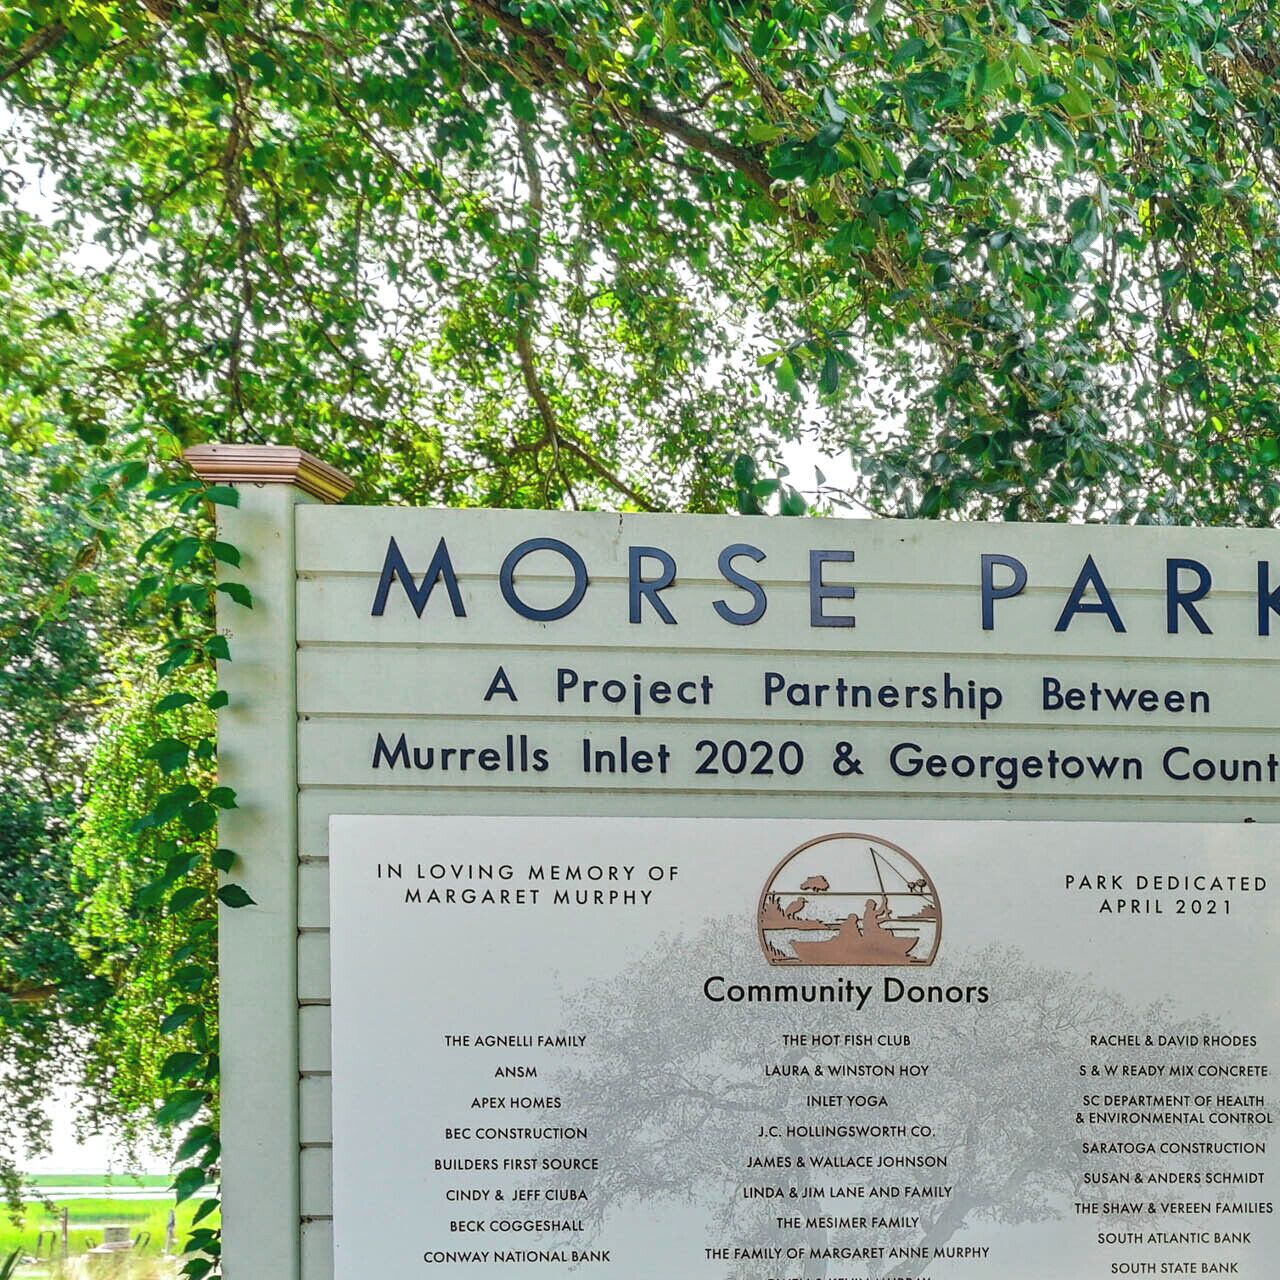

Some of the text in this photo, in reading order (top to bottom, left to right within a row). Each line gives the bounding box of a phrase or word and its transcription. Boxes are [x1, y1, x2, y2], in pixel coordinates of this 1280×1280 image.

[371, 537, 856, 627] MORSE
[485, 668, 1210, 714] A Project Partnership Between
[372, 733, 550, 774] Murrells
[581, 736, 671, 775] Inlet
[695, 739, 805, 775] 2020
[833, 742, 865, 776] &
[889, 743, 1144, 790] Georgetown
[377, 863, 678, 881] IN LOVING MEMORY OF
[1065, 874, 1266, 892] PARK DEDICATED
[405, 888, 652, 905] MARGARET MURPHY
[1099, 898, 1230, 915] APRIL 2021
[703, 975, 989, 1011] Community Donors
[444, 1035, 587, 1047] THE AGNELLI FAMILY
[782, 1034, 911, 1047] THE HOT FISH CLUB
[1090, 1034, 1257, 1047] RACHEL & DAVID RHODES
[494, 1066, 538, 1078] ANSM
[765, 1064, 929, 1077] LAURA & WINSTON HOY
[470, 1096, 562, 1109] APEX HOMES
[806, 1095, 889, 1107] INLET YOGA
[1082, 1094, 1265, 1107] SC DEPARTMENT OF HEALTH
[1075, 1112, 1273, 1124] & ENVIRONMENTAL CONTROL
[445, 1127, 588, 1140] BEC CONSTRUCTION
[757, 1125, 936, 1138] J.C. HOLLINGSWORTH CO.
[1082, 1142, 1266, 1154] SARATOGA CONSTRUCTION
[434, 1158, 599, 1171] BUILDERS FIRST SOURCE
[746, 1155, 947, 1168] JAMES & WALLACE JOHNSON
[1074, 1202, 1273, 1215] THE SHAW & VEREEN FAMILIES
[450, 1219, 585, 1232] BECK COGGESHALL
[776, 1216, 919, 1229] THE MESIMER FAMILY
[1097, 1232, 1251, 1244] SOUTH ATLANTIC BANK
[423, 1250, 610, 1263] CONWAY NATIONAL BANK
